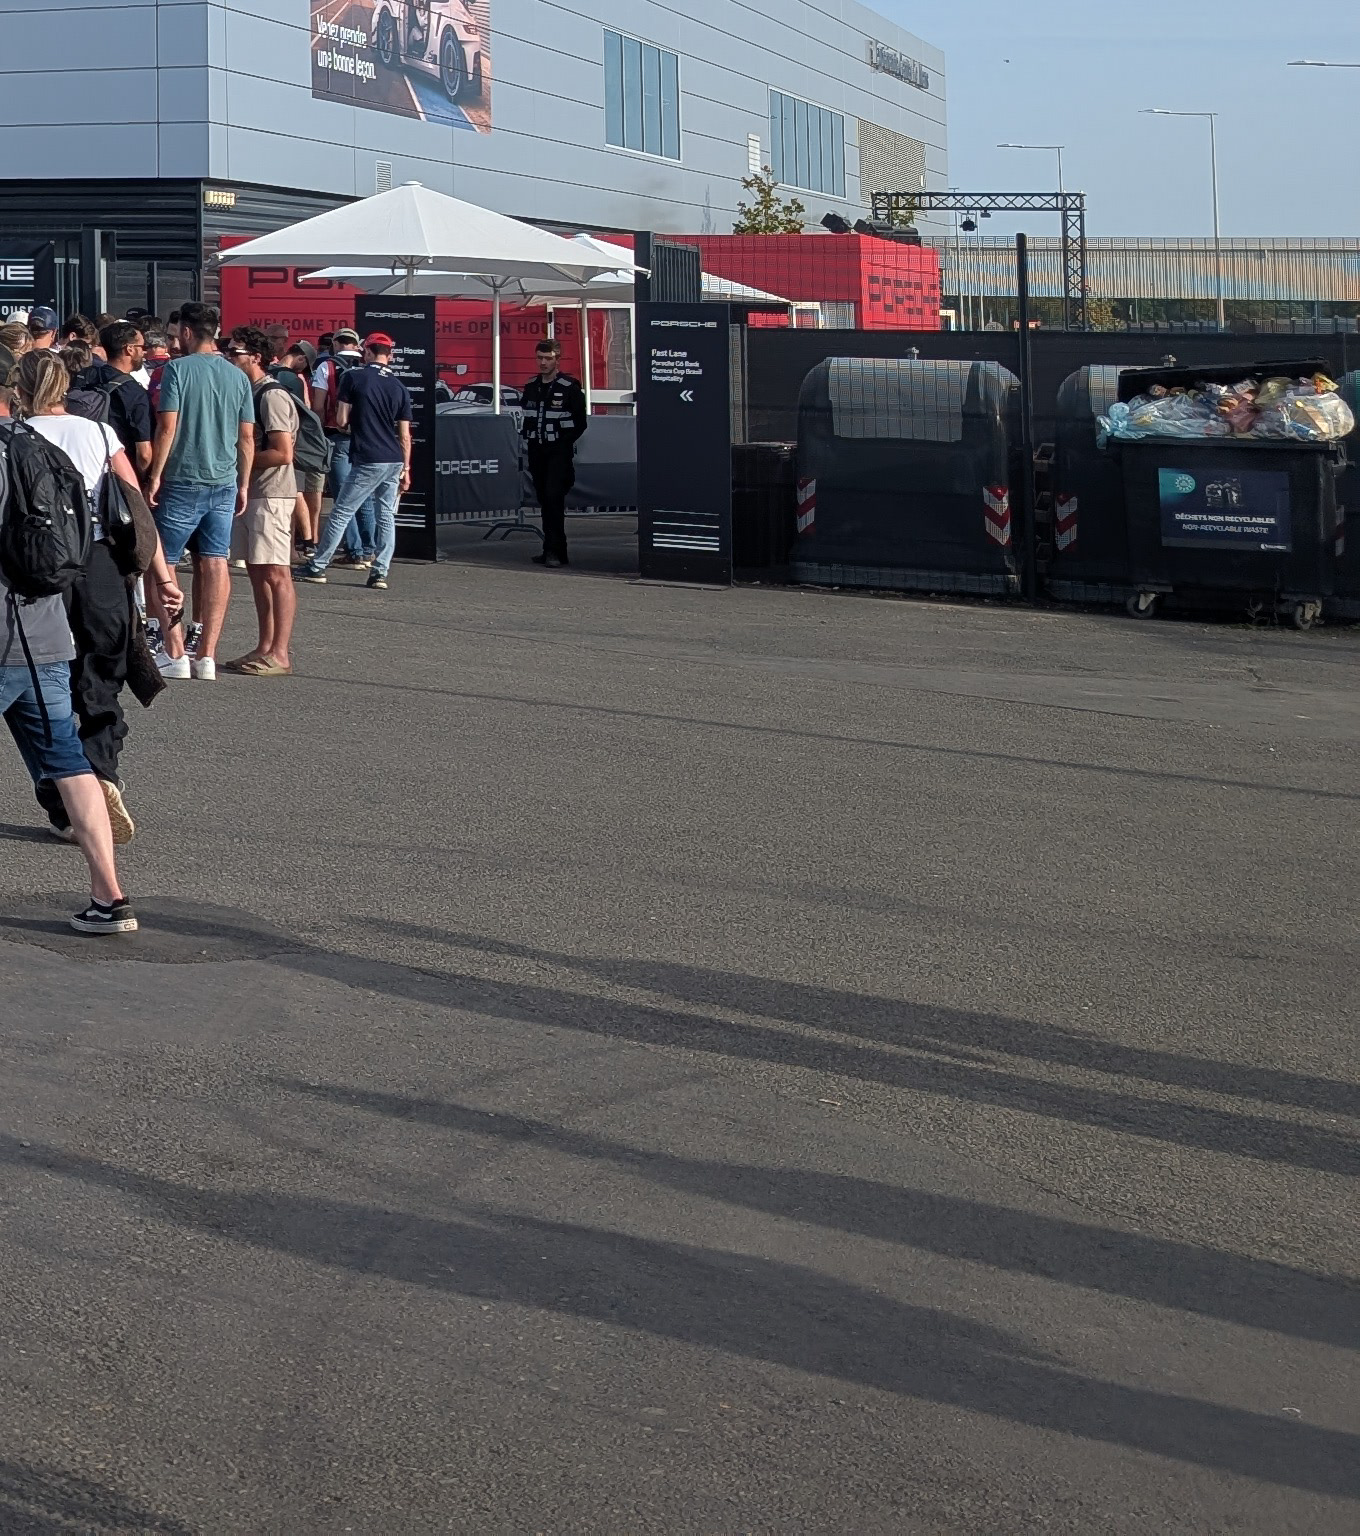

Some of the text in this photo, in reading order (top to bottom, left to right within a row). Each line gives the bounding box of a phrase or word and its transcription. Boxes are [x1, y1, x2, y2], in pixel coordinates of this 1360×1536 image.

[316, 13, 367, 49] Venez prendre
[317, 46, 377, 84] une bonne leçon.
[365, 311, 425, 320] PORSCHE
[328, 319, 349, 333] TO
[650, 320, 718, 328] PORSCHE
[404, 347, 426, 355] House
[668, 349, 687, 358] Lane
[673, 367, 685, 376] Cup
[651, 374, 684, 384] Hospitality
[1174, 512, 1208, 522] DÉCHETS
[1208, 514, 1225, 523] NON
[1182, 523, 1269, 535] NON-RECYCLABLE WASTE
